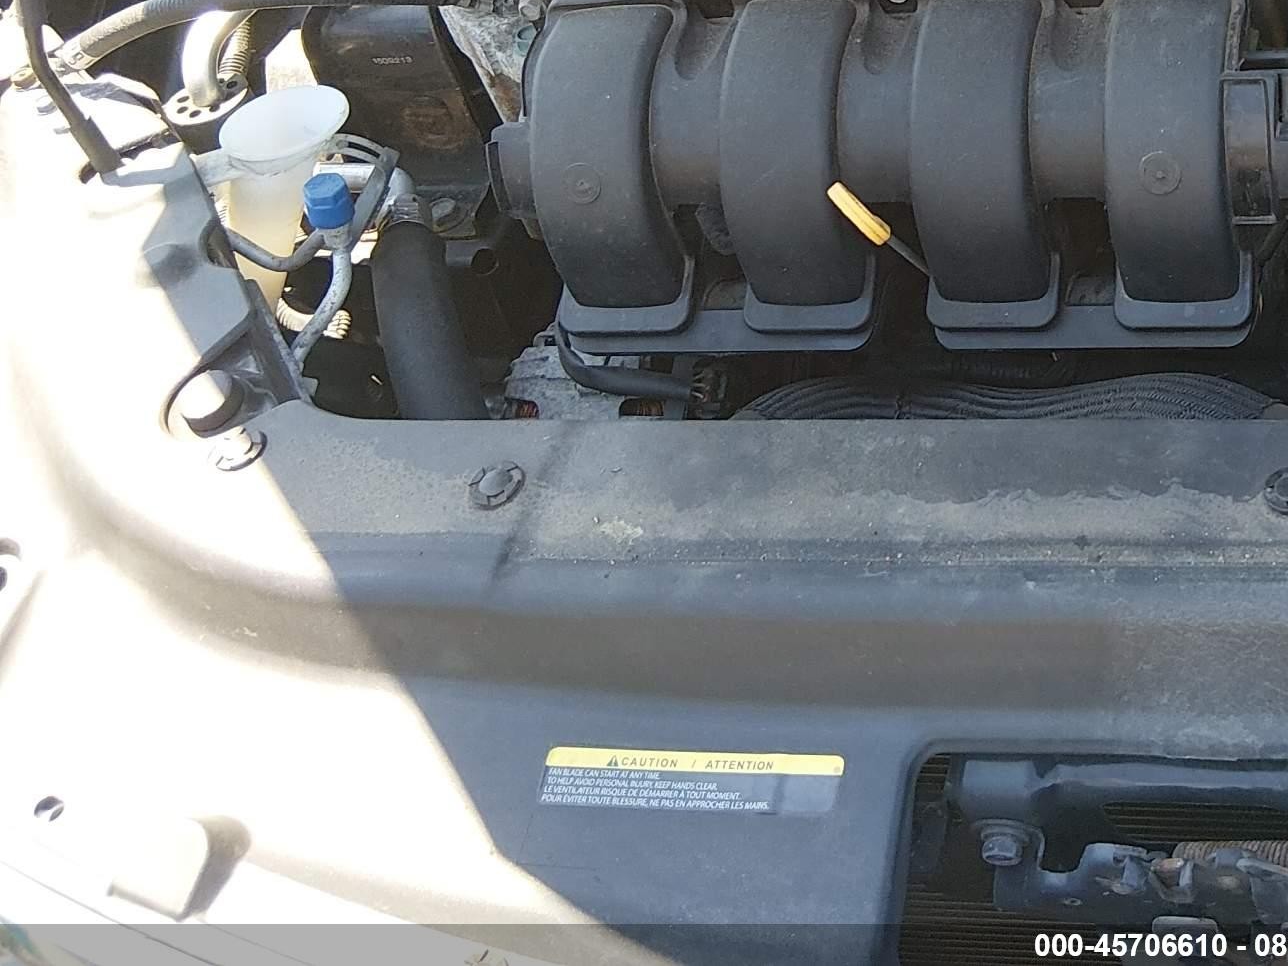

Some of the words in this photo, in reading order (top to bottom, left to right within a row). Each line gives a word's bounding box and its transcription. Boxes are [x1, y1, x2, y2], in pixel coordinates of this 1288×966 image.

[621, 756, 678, 768] CAUTION
[705, 760, 774, 771] ATTENTION
[548, 767, 562, 775] FAN
[562, 768, 584, 776] BLADE
[584, 769, 599, 777] CAN
[600, 770, 619, 778] START
[627, 771, 644, 779] ANY
[558, 777, 574, 785] HELP
[574, 778, 594, 786] AVOID
[596, 779, 629, 787] PERSONAL
[654, 781, 671, 789] KEEP
[553, 786, 600, 795] VENTILATEUR
[601, 787, 627, 796] RISQUE
[638, 788, 678, 798] DÉMARRER
[679, 790, 684, 798] À
[686, 791, 706, 799] TOUT
[706, 792, 742, 800] MOMENT.
[541, 794, 562, 802] POUR
[563, 794, 587, 803] ÉVITER
[588, 796, 611, 804] TOUTE
[611, 797, 649, 807] BLESSURE,
[649, 799, 660, 807] NE
[660, 800, 674, 808] PAS
[675, 800, 686, 808] EN
[686, 801, 730, 809] APPROCHER
[744, 802, 770, 810] MAINS.
